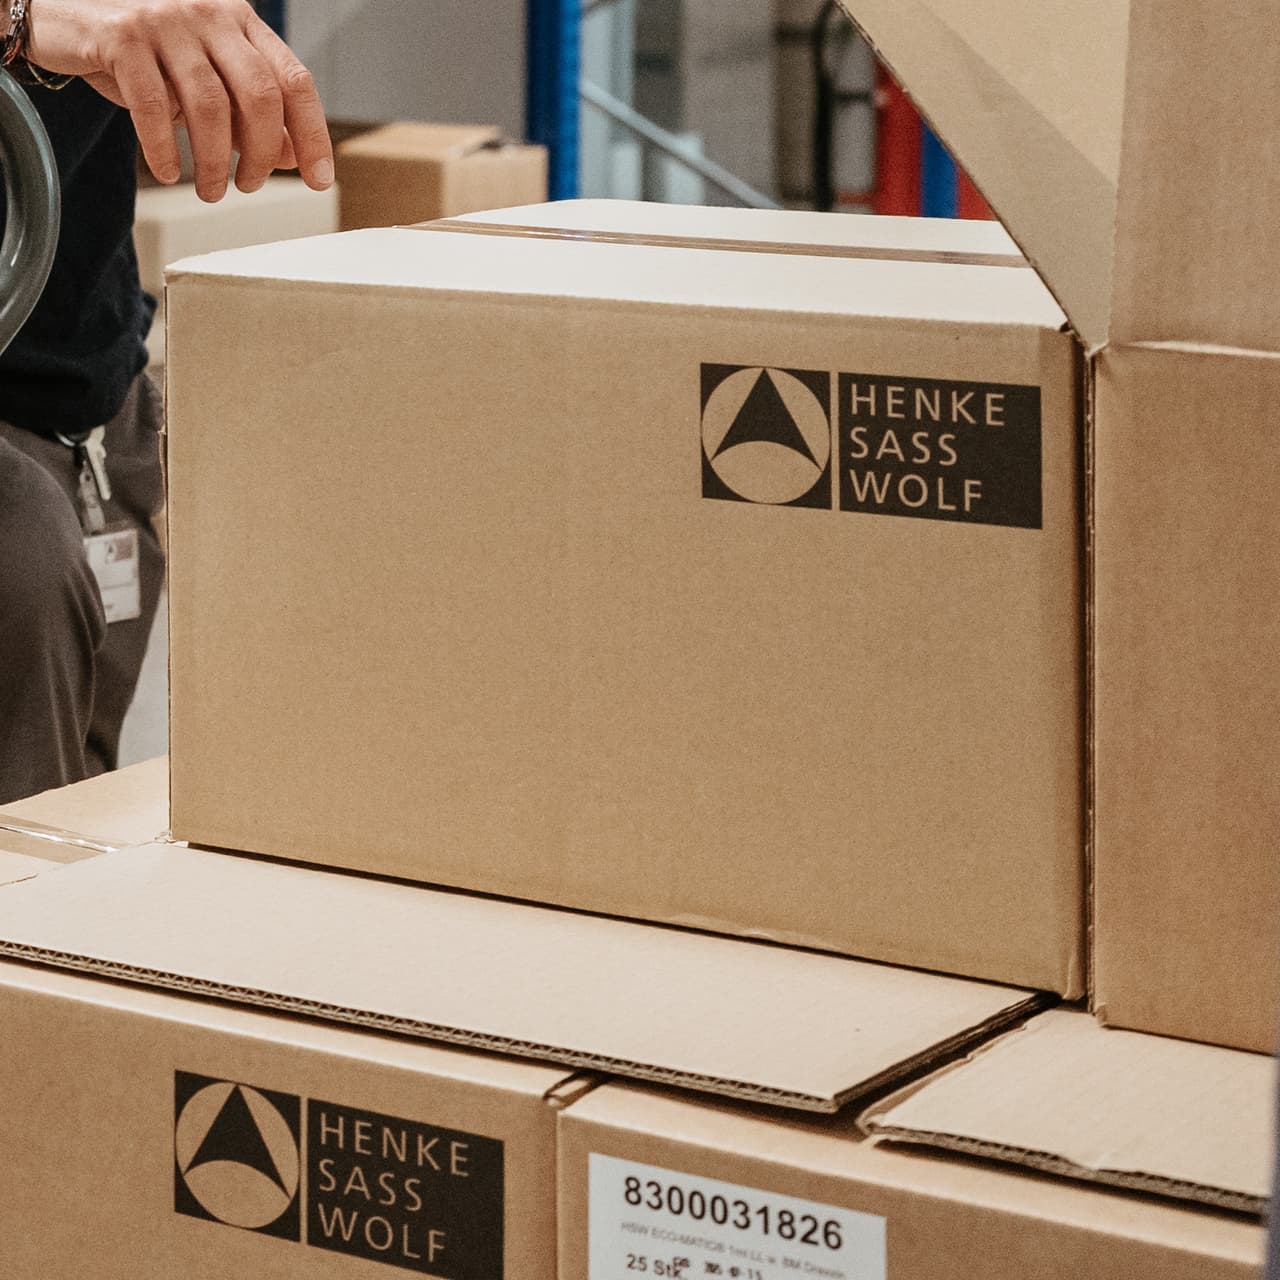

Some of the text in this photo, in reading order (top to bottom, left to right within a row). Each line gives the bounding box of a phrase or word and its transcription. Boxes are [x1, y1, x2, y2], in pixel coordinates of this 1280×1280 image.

[850, 383, 1005, 426] HENKE
[850, 426, 958, 466] SASS
[849, 469, 982, 512] WOLF
[320, 1111, 470, 1177] HENKE
[319, 1158, 422, 1212] SASS
[317, 1202, 445, 1263] WOLF
[624, 1176, 843, 1250] 8300031826
[626, 1253, 648, 1272] 25
